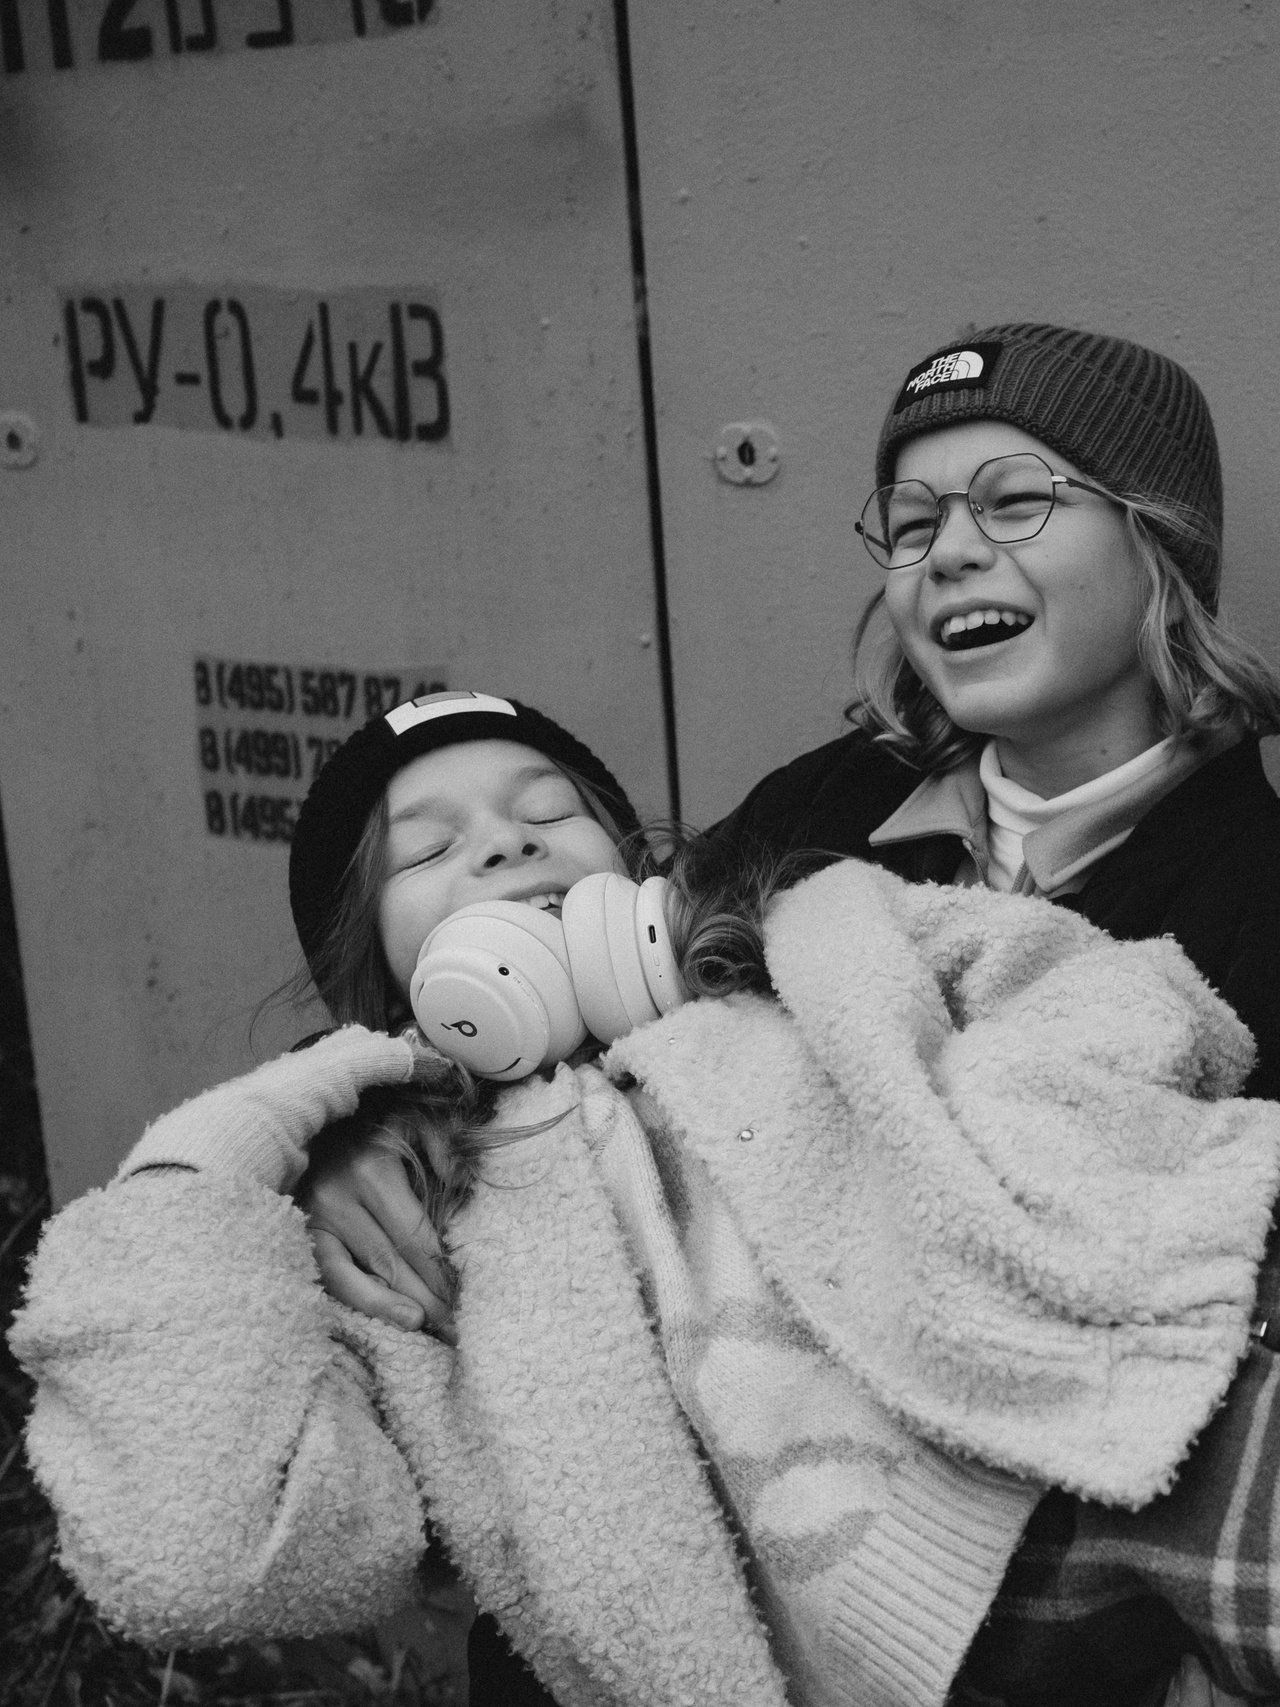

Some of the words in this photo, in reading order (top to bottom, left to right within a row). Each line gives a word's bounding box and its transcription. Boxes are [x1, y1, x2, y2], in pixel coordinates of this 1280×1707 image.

[931, 353, 960, 369] THE
[906, 361, 957, 391] NORTH
[914, 371, 951, 393] FACE
